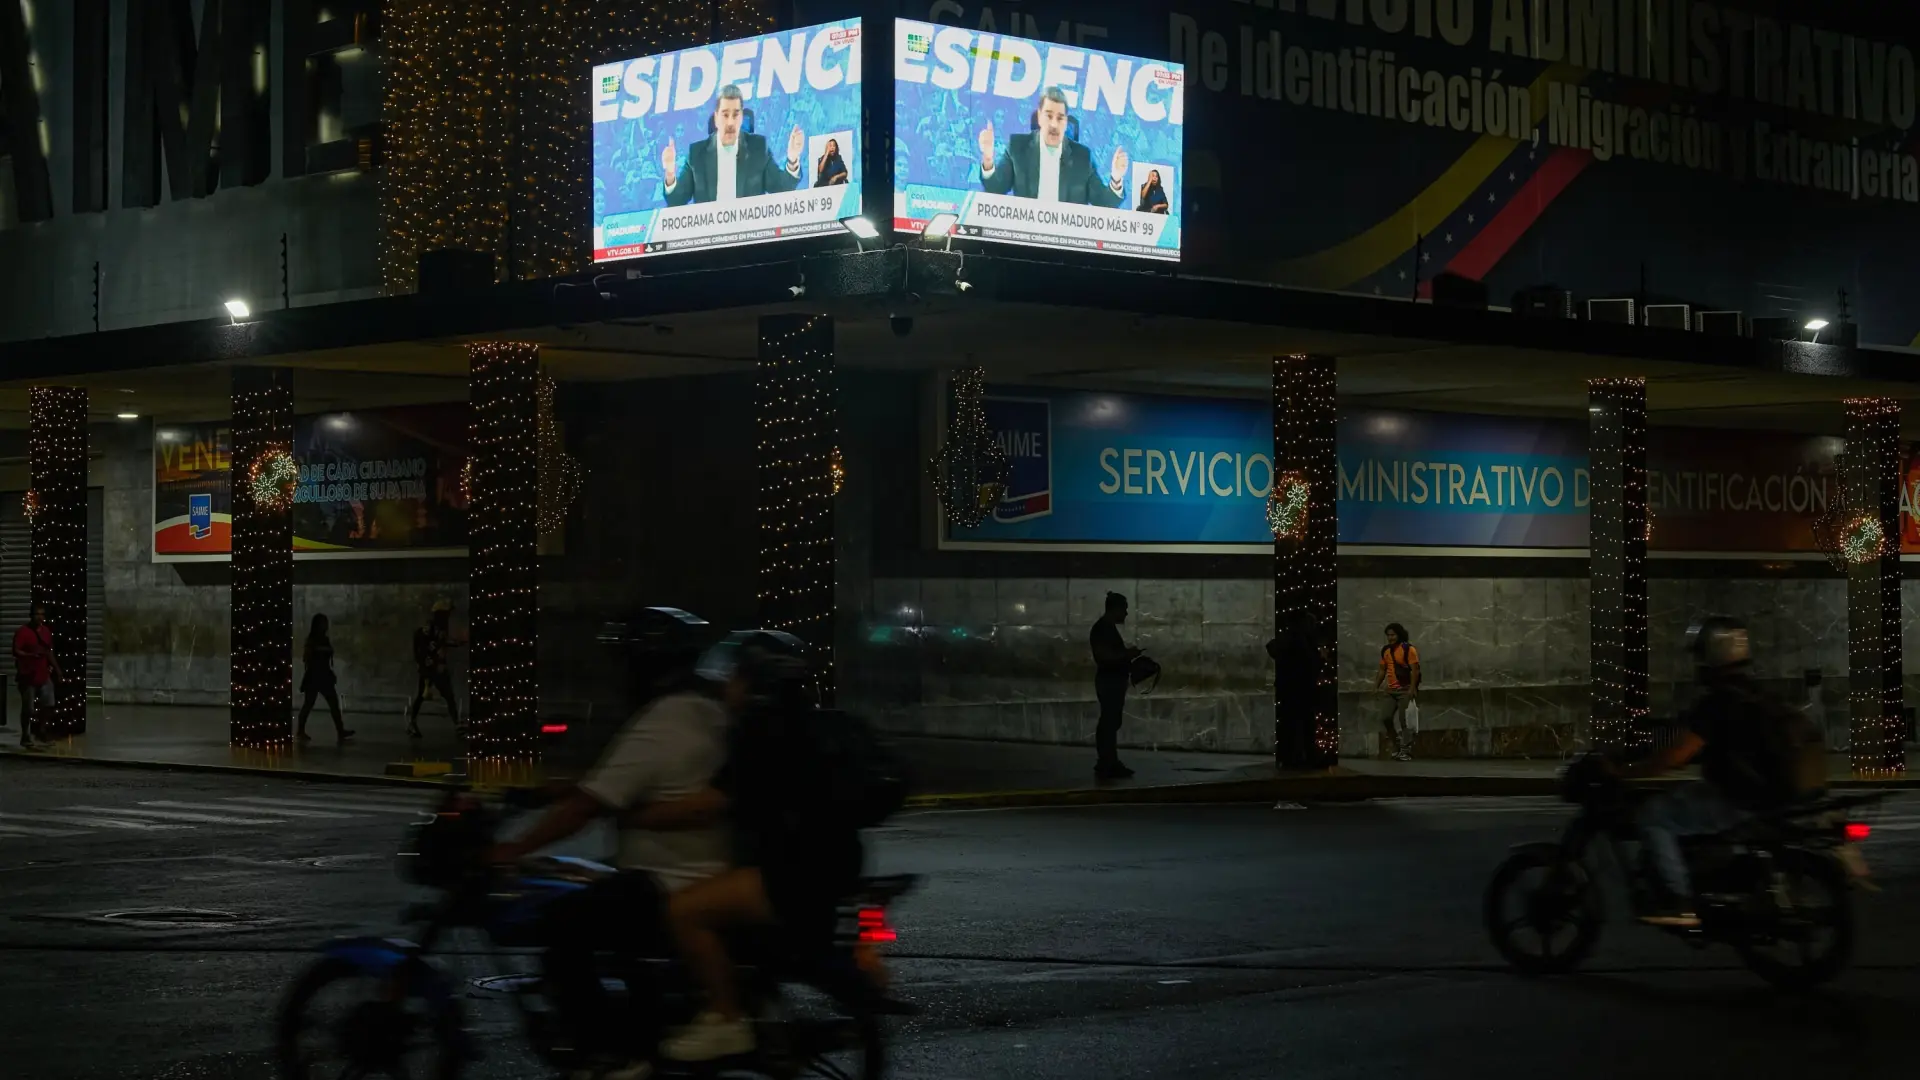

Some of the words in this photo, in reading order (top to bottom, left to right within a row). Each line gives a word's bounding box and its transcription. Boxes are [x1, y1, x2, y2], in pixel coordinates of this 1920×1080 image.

[1169, 10, 1228, 93] De
[1240, 23, 1540, 149] Identificación,
[1547, 80, 1720, 173] Migración
[1753, 117, 1919, 203] Extranjería
[662, 211, 715, 231] PROGRAMA
[716, 209, 737, 224] CON
[740, 203, 782, 222] MADURO
[784, 198, 805, 216] MÁS
[821, 197, 832, 211] 99
[977, 203, 1035, 223] PROGRAMA
[1037, 210, 1058, 225] CON
[1061, 213, 1104, 230] MADURO
[1106, 216, 1128, 232] MÁS
[1142, 222, 1154, 236] 99
[606, 246, 641, 257] VTV.GOB.VE
[311, 463, 325, 481] DE
[326, 461, 358, 482] CADA
[359, 457, 427, 480] CIUDADANO
[1099, 447, 1274, 499] SERVICIO
[1337, 458, 1564, 508] MINISTRATIVO
[1646, 466, 1828, 514] ENTIFICACIÓN
[294, 482, 352, 504] RGULLOSO
[353, 481, 369, 501] DE
[369, 481, 386, 500] SU
[386, 479, 427, 500] PATRIA
[192, 505, 209, 517] SAIME
